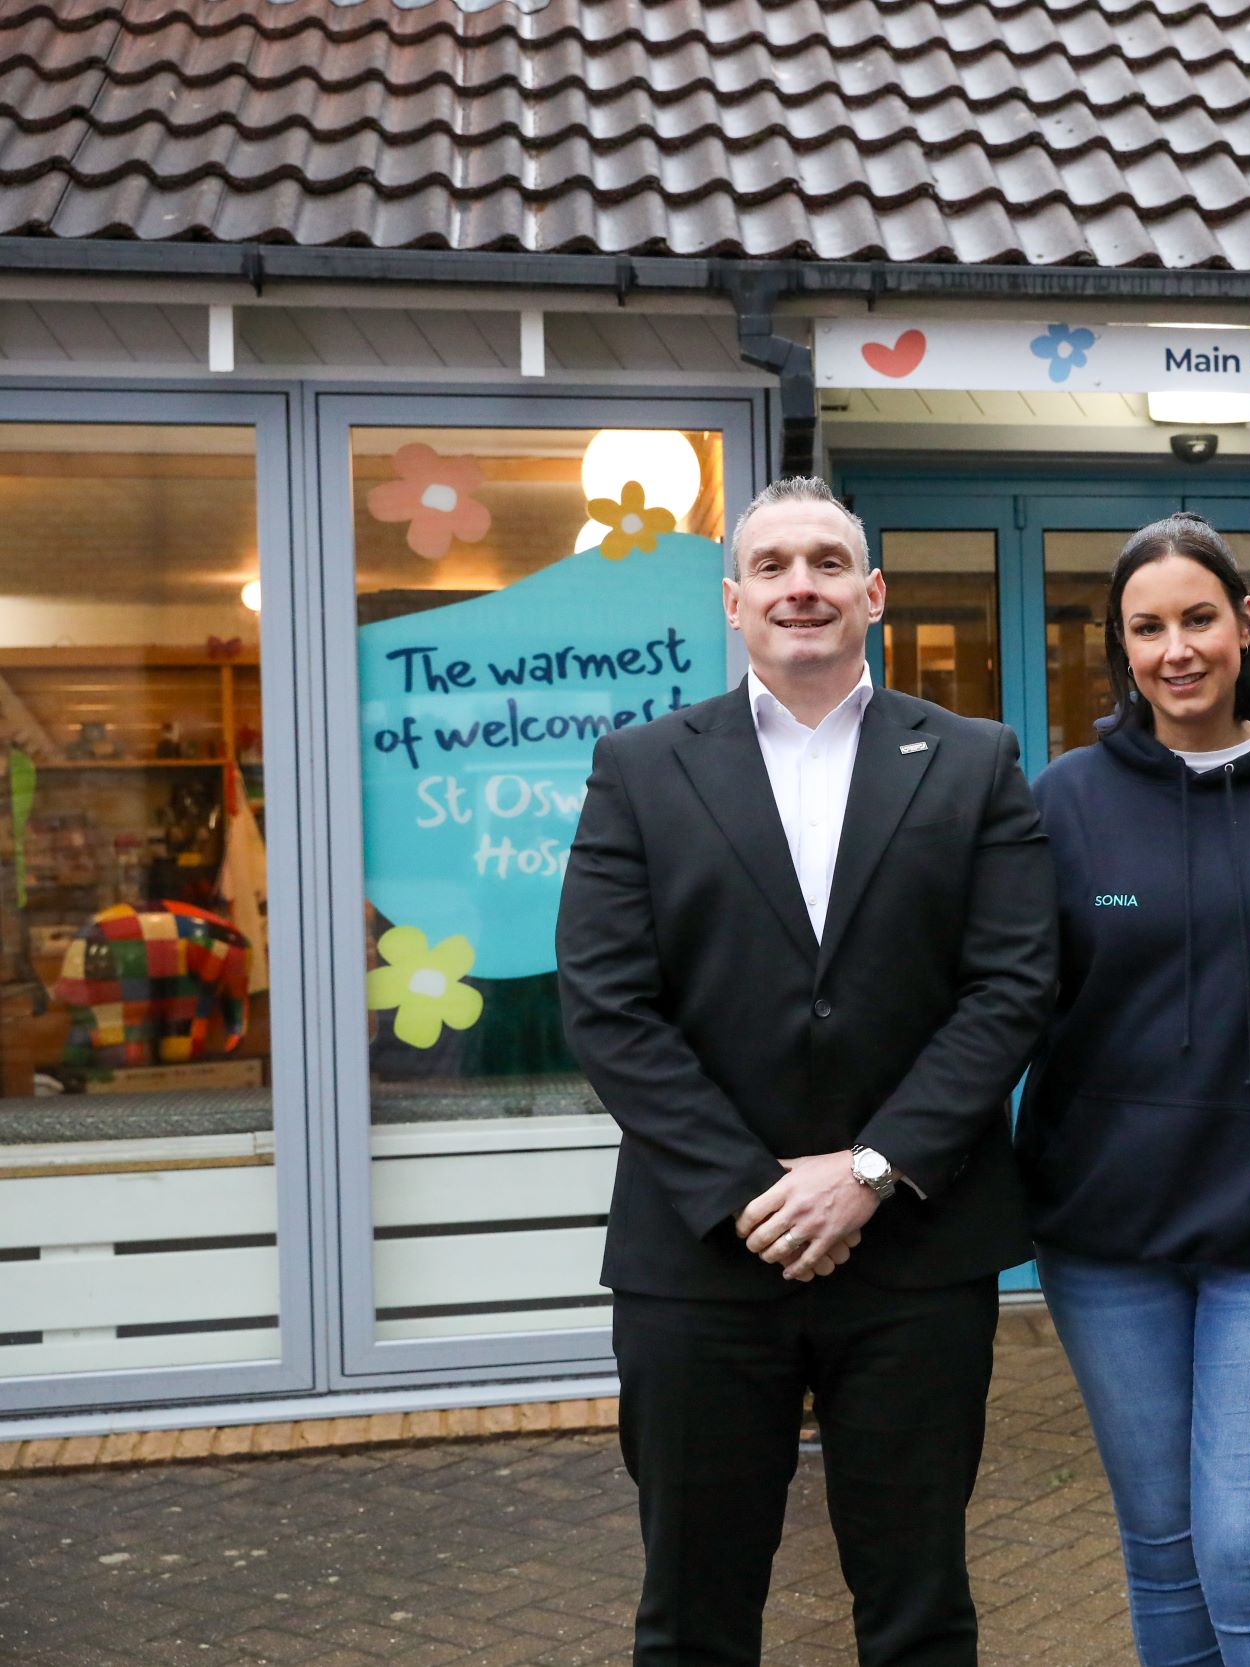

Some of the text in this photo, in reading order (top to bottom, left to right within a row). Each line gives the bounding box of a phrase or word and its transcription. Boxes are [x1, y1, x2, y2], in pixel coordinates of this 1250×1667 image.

[1165, 346, 1241, 373] Main
[386, 627, 692, 694] The warmest
[374, 716, 422, 769] of
[416, 775, 473, 828] St
[1094, 894, 1138, 907] SONIA
